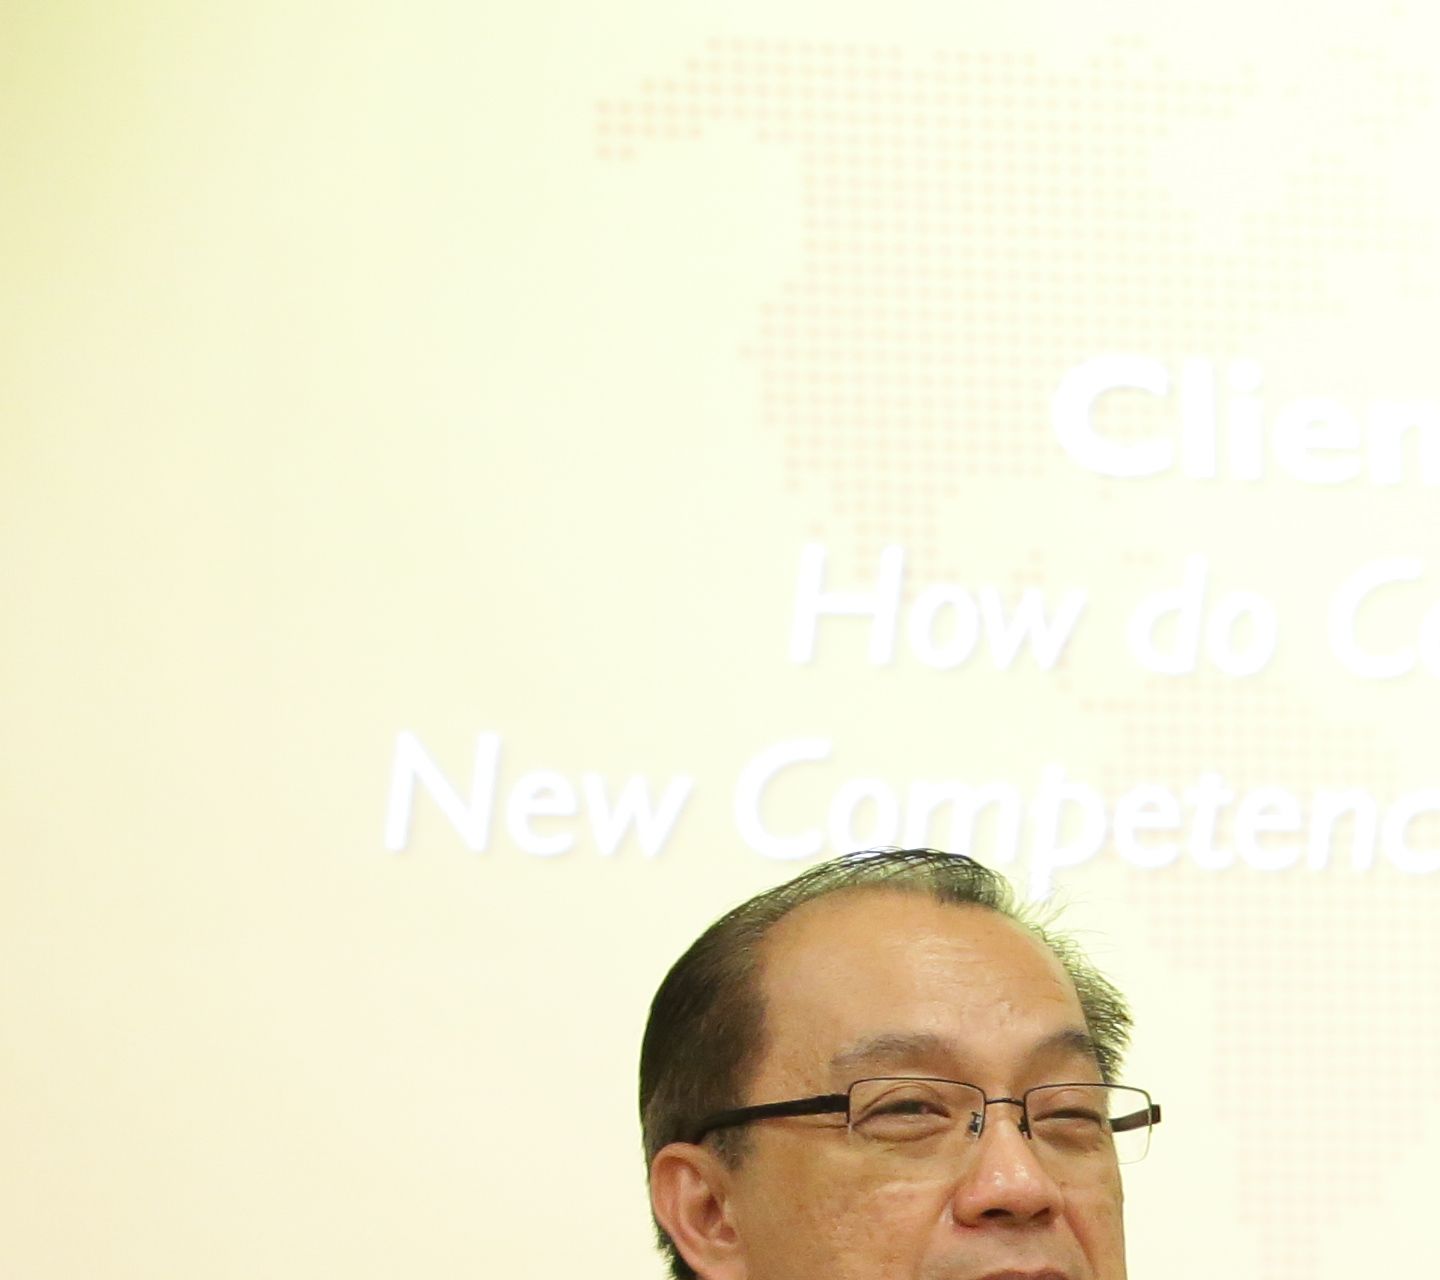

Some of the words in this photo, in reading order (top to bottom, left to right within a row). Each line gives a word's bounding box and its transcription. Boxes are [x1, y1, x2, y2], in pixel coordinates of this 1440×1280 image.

[784, 542, 1089, 673] How
[1125, 551, 1281, 678] do
[381, 729, 695, 862] New
